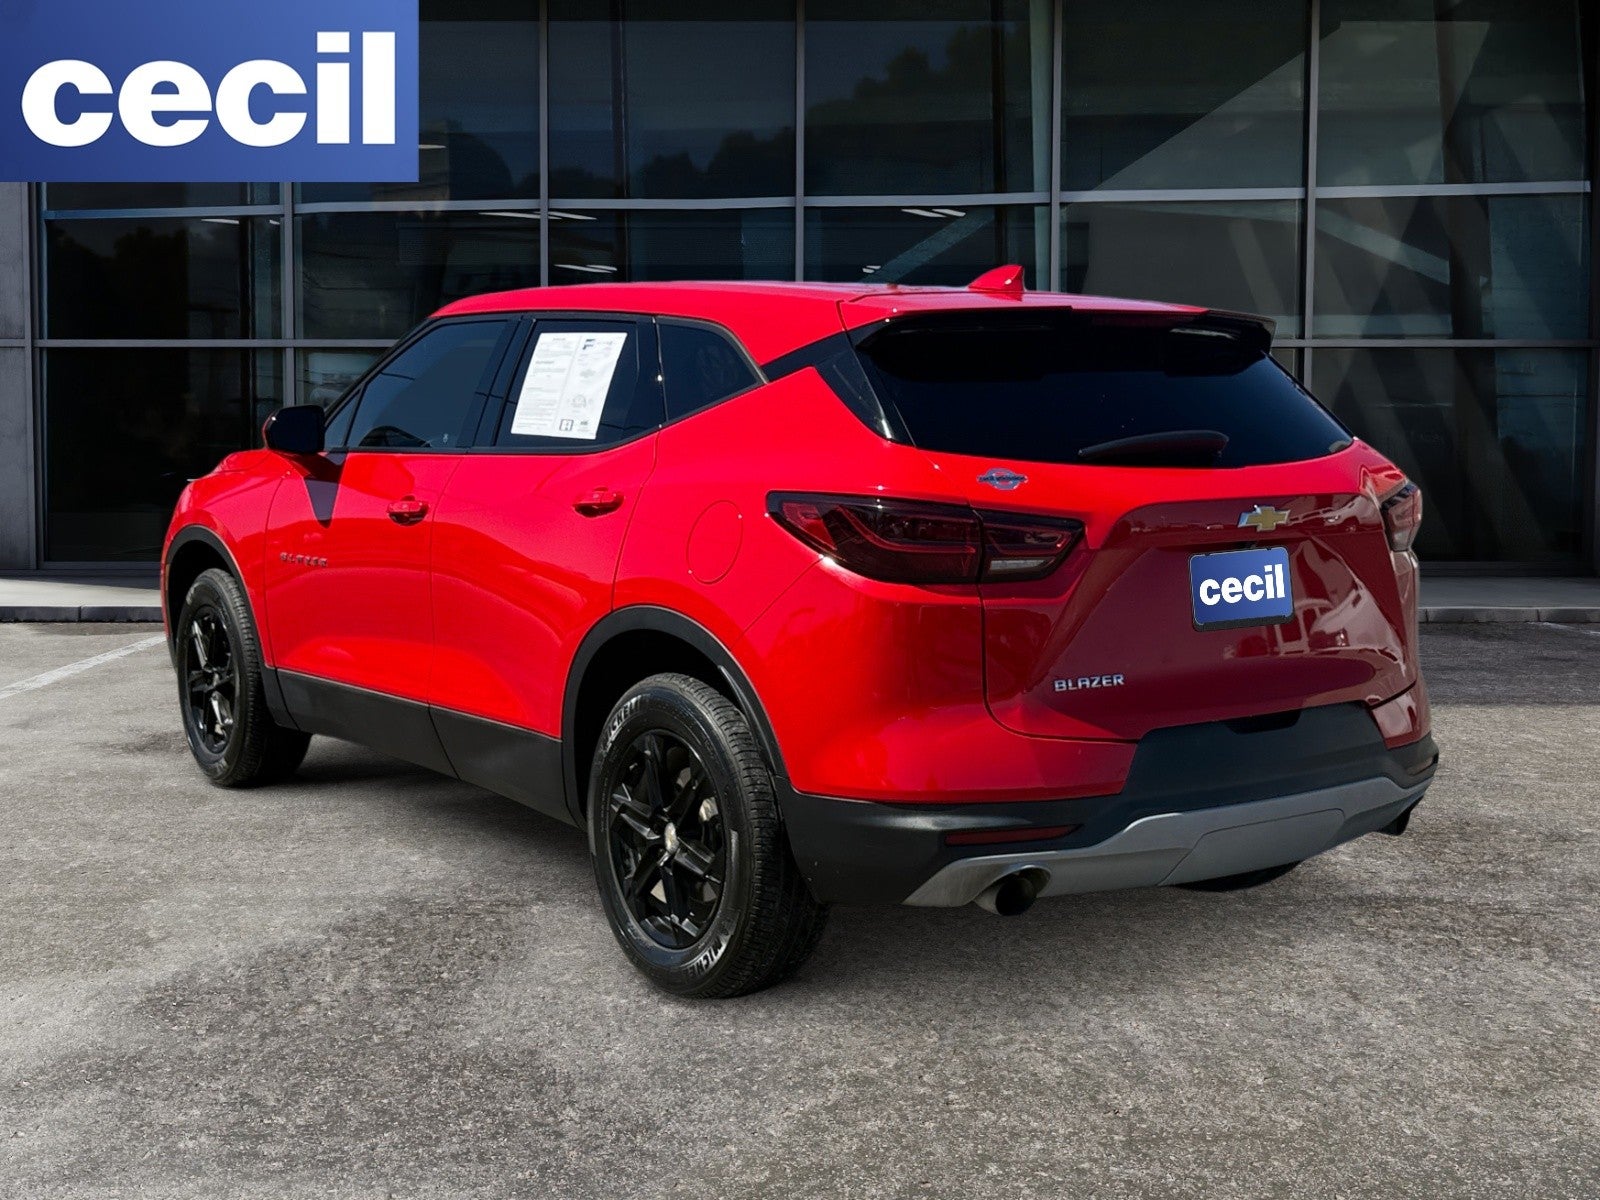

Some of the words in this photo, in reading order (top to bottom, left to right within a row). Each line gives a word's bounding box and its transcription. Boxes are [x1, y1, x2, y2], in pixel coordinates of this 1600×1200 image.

[1054, 674, 1125, 692] BLAZER
[602, 694, 644, 752] MICHELI
[679, 935, 725, 978] MICHEL
